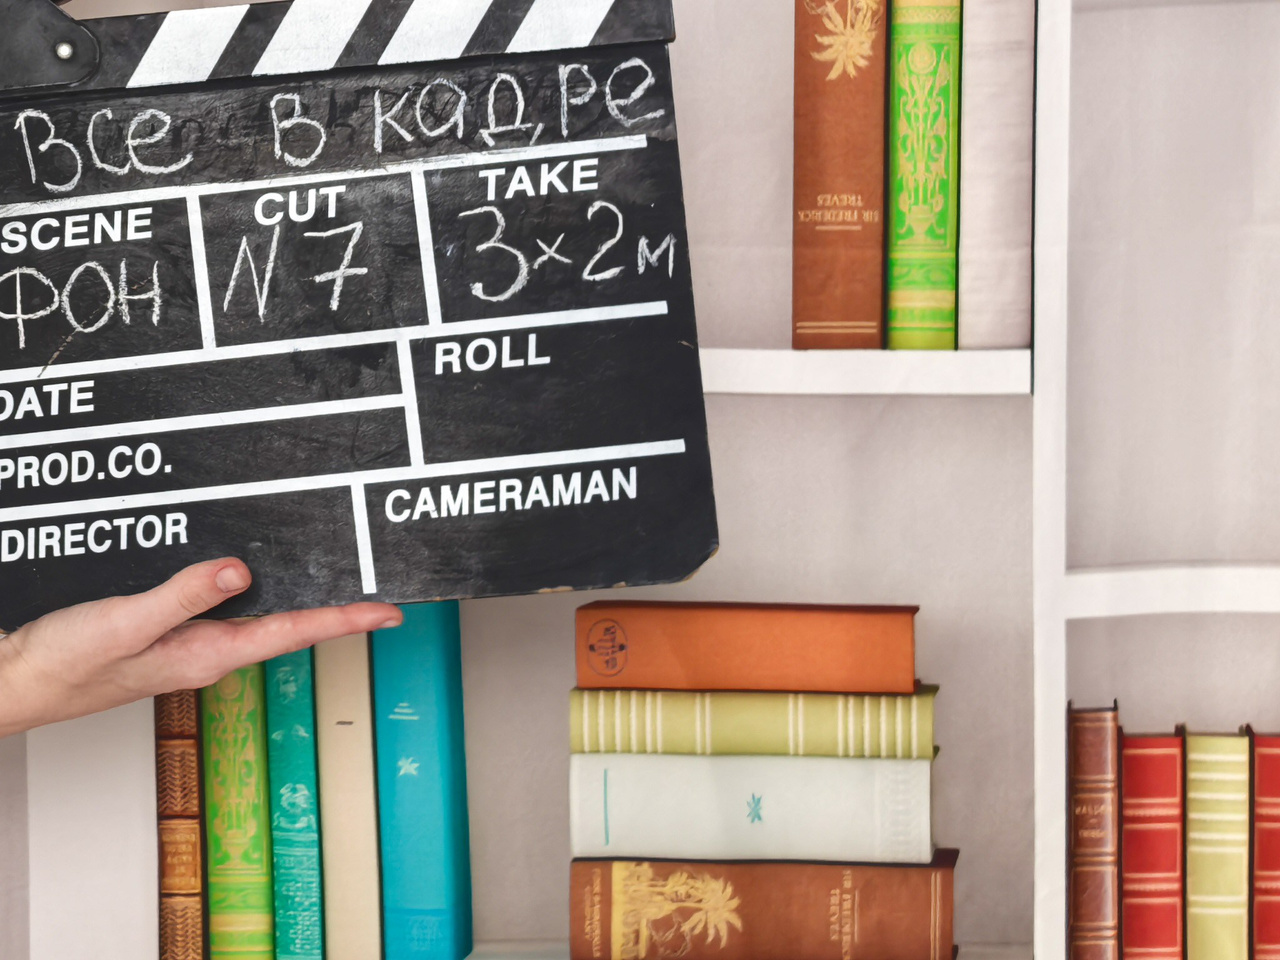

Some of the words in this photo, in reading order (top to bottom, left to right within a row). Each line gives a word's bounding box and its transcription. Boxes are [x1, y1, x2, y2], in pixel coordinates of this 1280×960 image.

[478, 157, 600, 202] TAKE
[253, 185, 347, 226] CUT
[0, 207, 153, 254] SCENE
[433, 332, 551, 375] ROLL
[383, 467, 639, 524] CAMERAMAN
